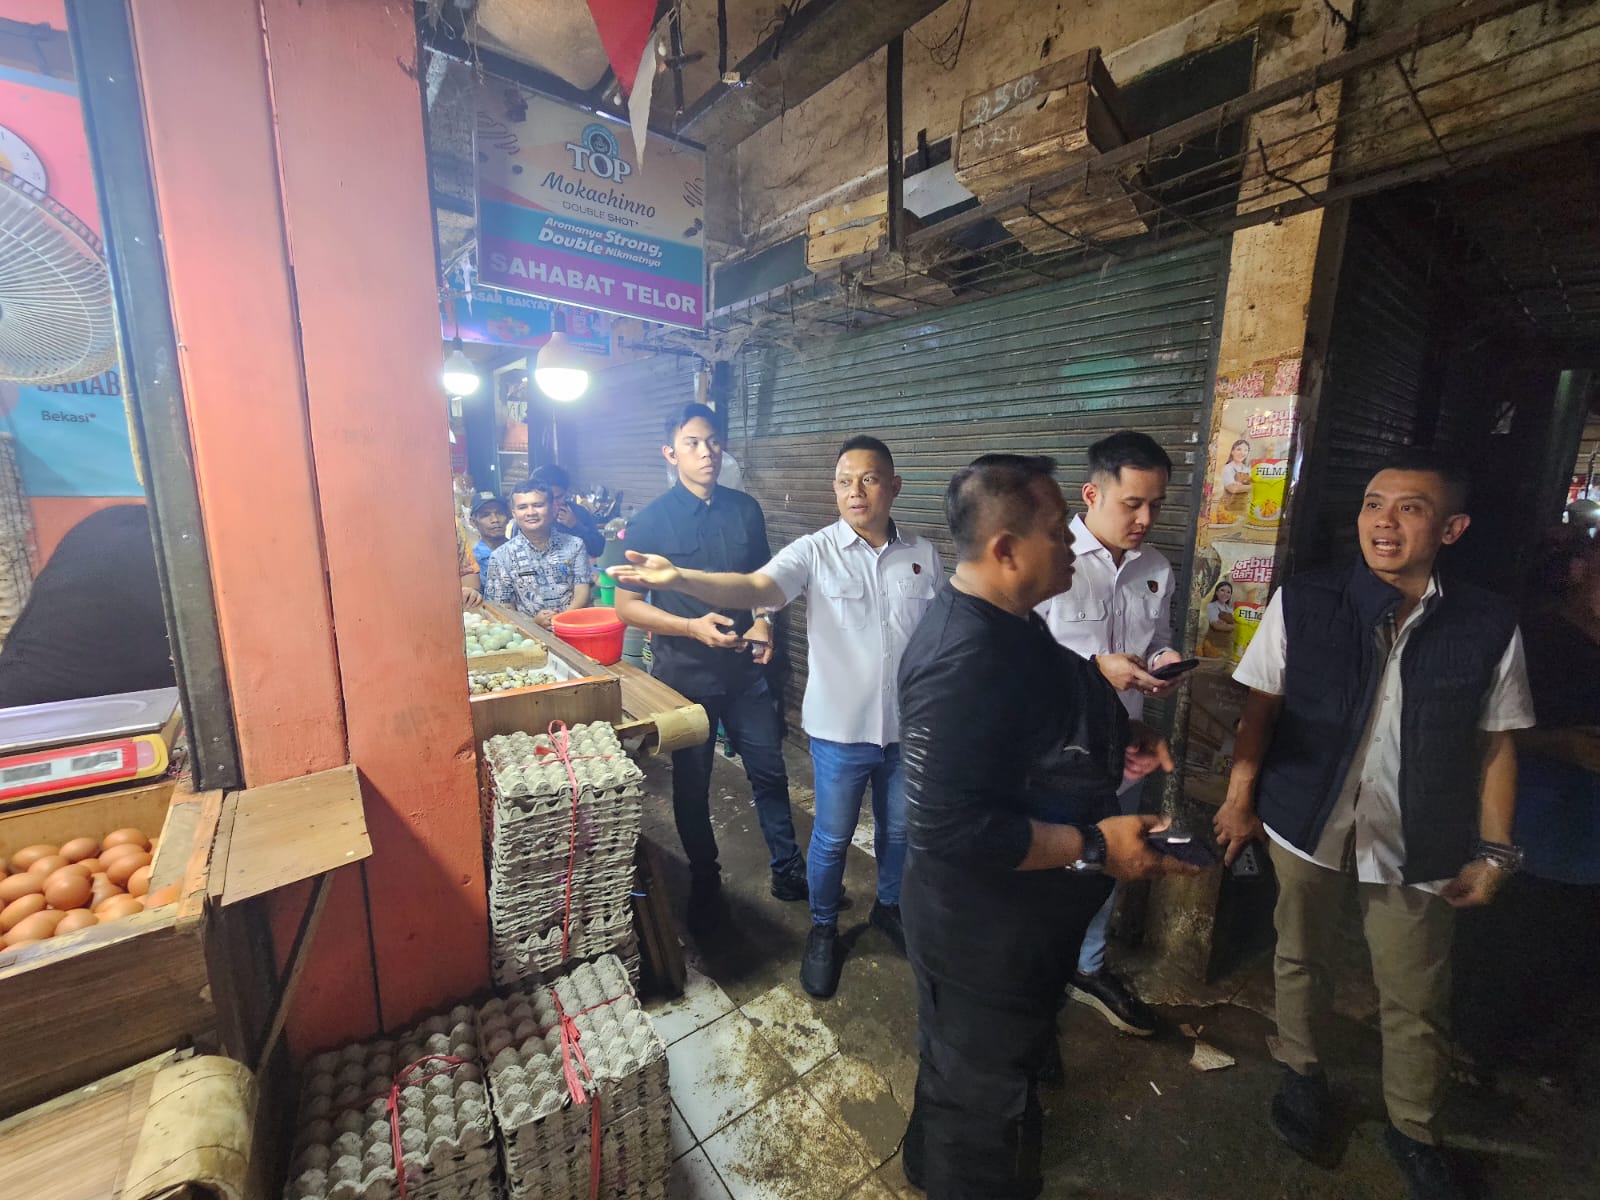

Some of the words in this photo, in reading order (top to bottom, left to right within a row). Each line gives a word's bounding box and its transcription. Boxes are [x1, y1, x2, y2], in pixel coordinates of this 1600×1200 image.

[566, 143, 631, 184] TOP
[540, 171, 656, 218] Mokachinno
[562, 200, 606, 219] DOUBLE
[538, 227, 603, 254] Double
[545, 217, 602, 238] Aromanya
[603, 230, 663, 257] Strong,
[491, 252, 615, 296] SAHABAT
[622, 281, 697, 314] TELOR
[41, 410, 90, 423] Bekasi
